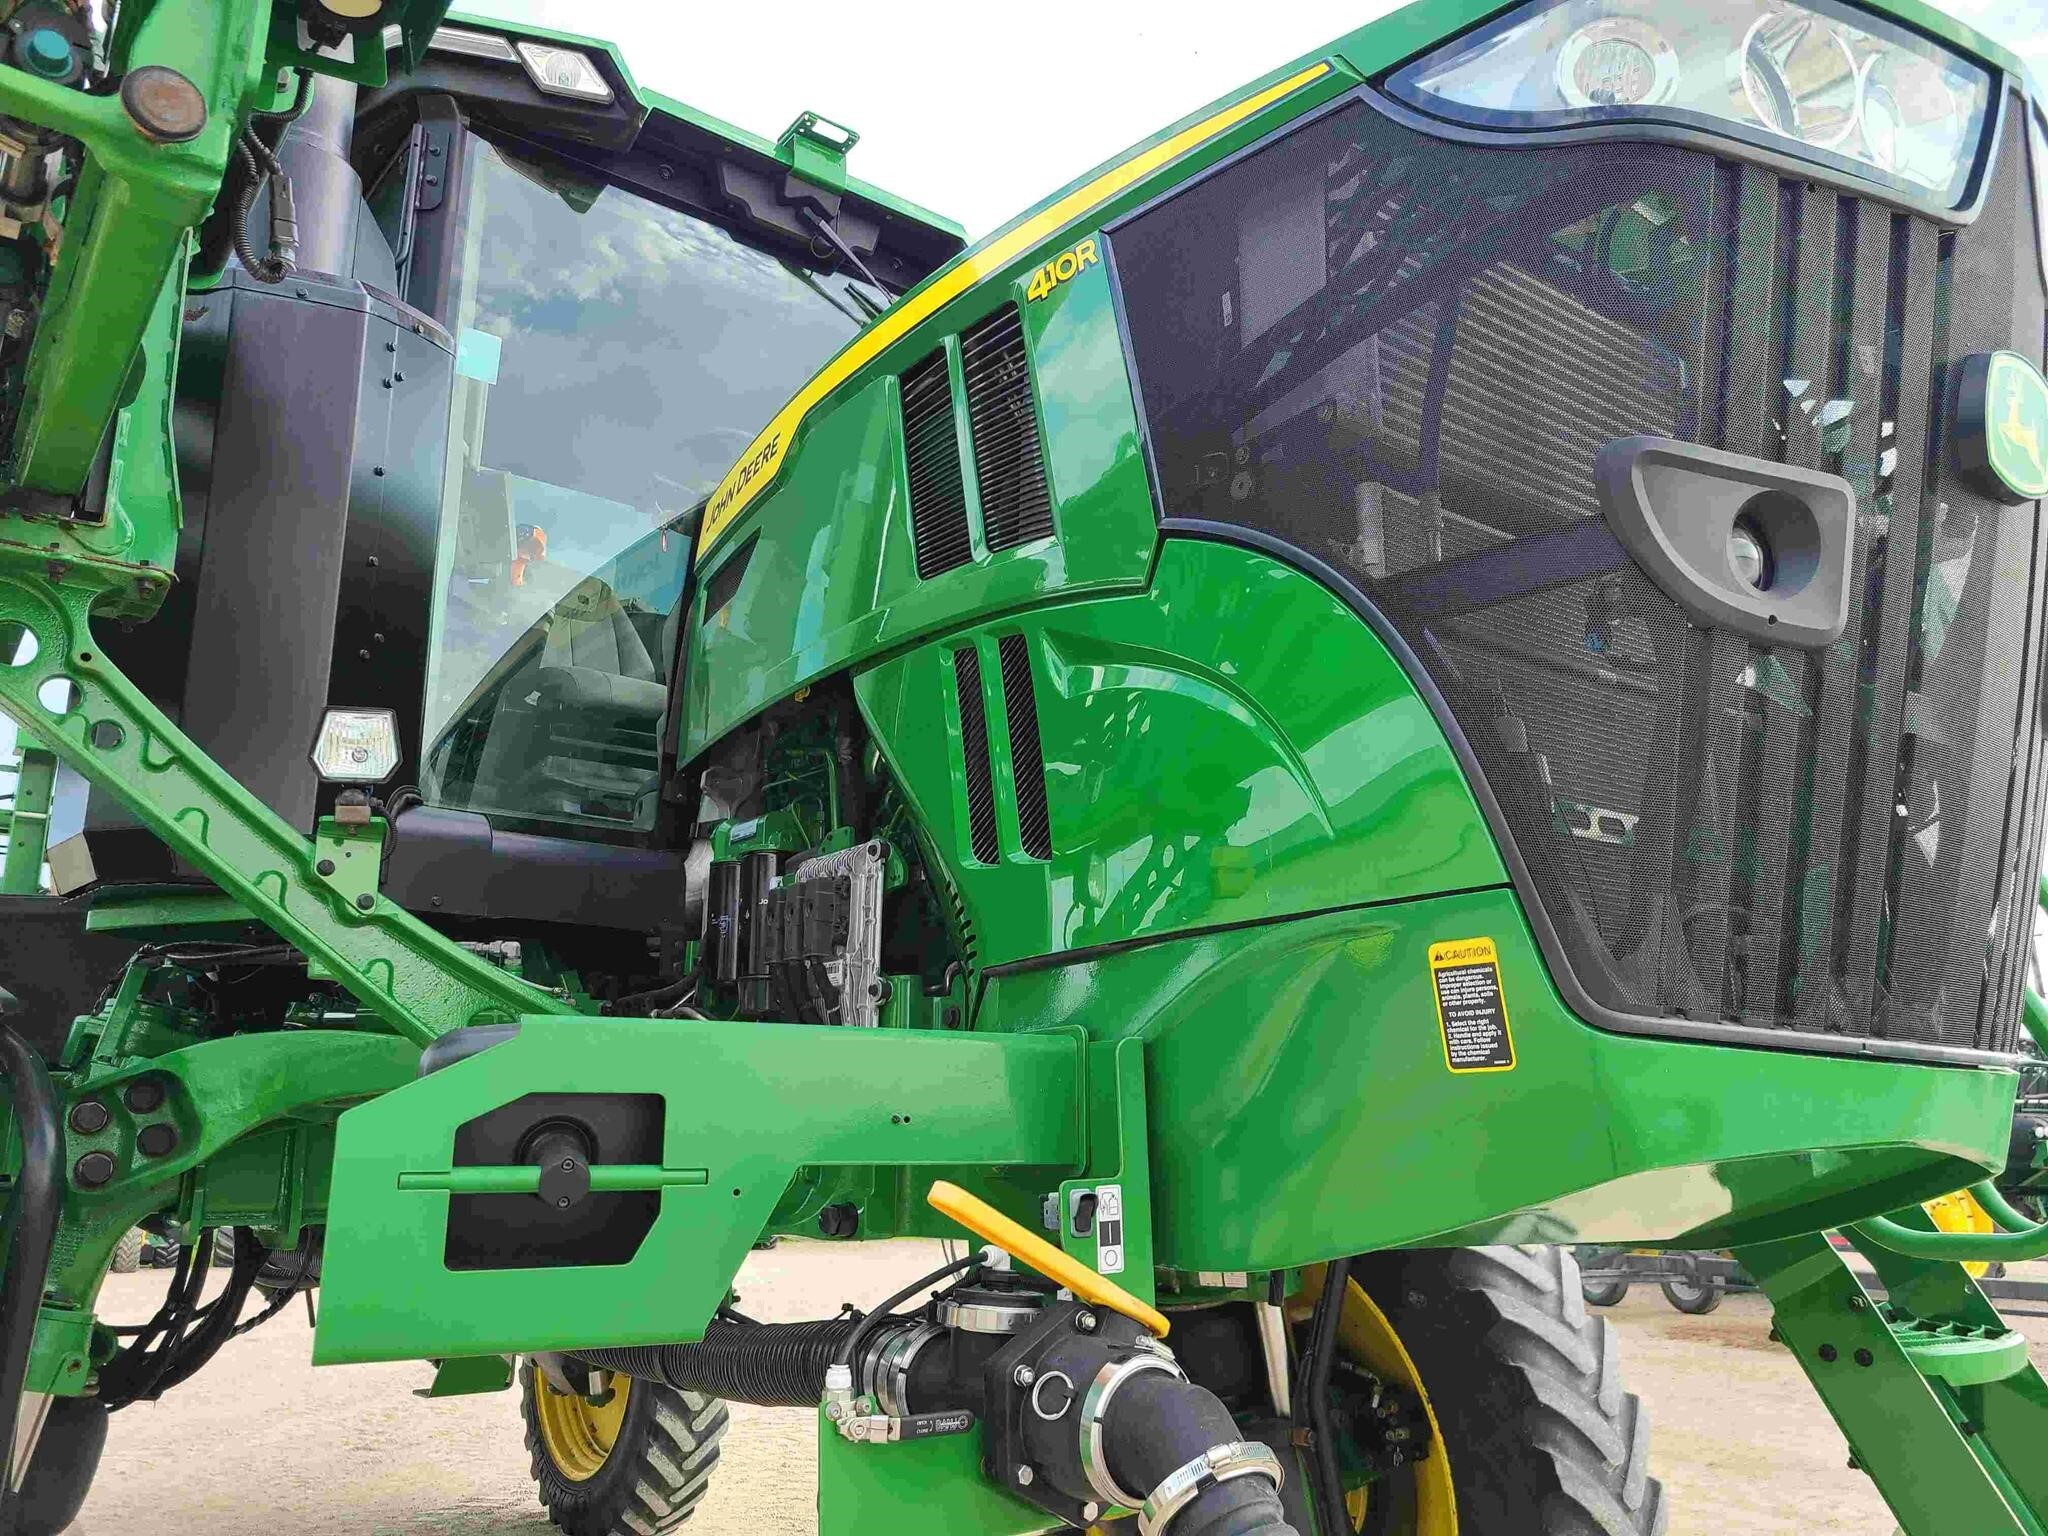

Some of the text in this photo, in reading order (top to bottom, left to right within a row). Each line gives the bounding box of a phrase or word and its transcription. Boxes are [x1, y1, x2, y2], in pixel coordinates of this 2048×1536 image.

[1026, 239, 1099, 303] 410R
[706, 432, 781, 533] JOHN DEERE
[1445, 946, 1491, 960] CAUTION
[1438, 969, 1467, 978] Agricultural
[1456, 974, 1484, 982] dangerous.
[1439, 982, 1462, 990] Improper
[1460, 986, 1475, 994] injure
[1462, 998, 1486, 1006] property.
[1475, 1008, 1496, 1016] INJURY
[1477, 1018, 1489, 1026] right
[1482, 1030, 1497, 1038] apply
[1450, 1043, 1480, 1051] instructions
